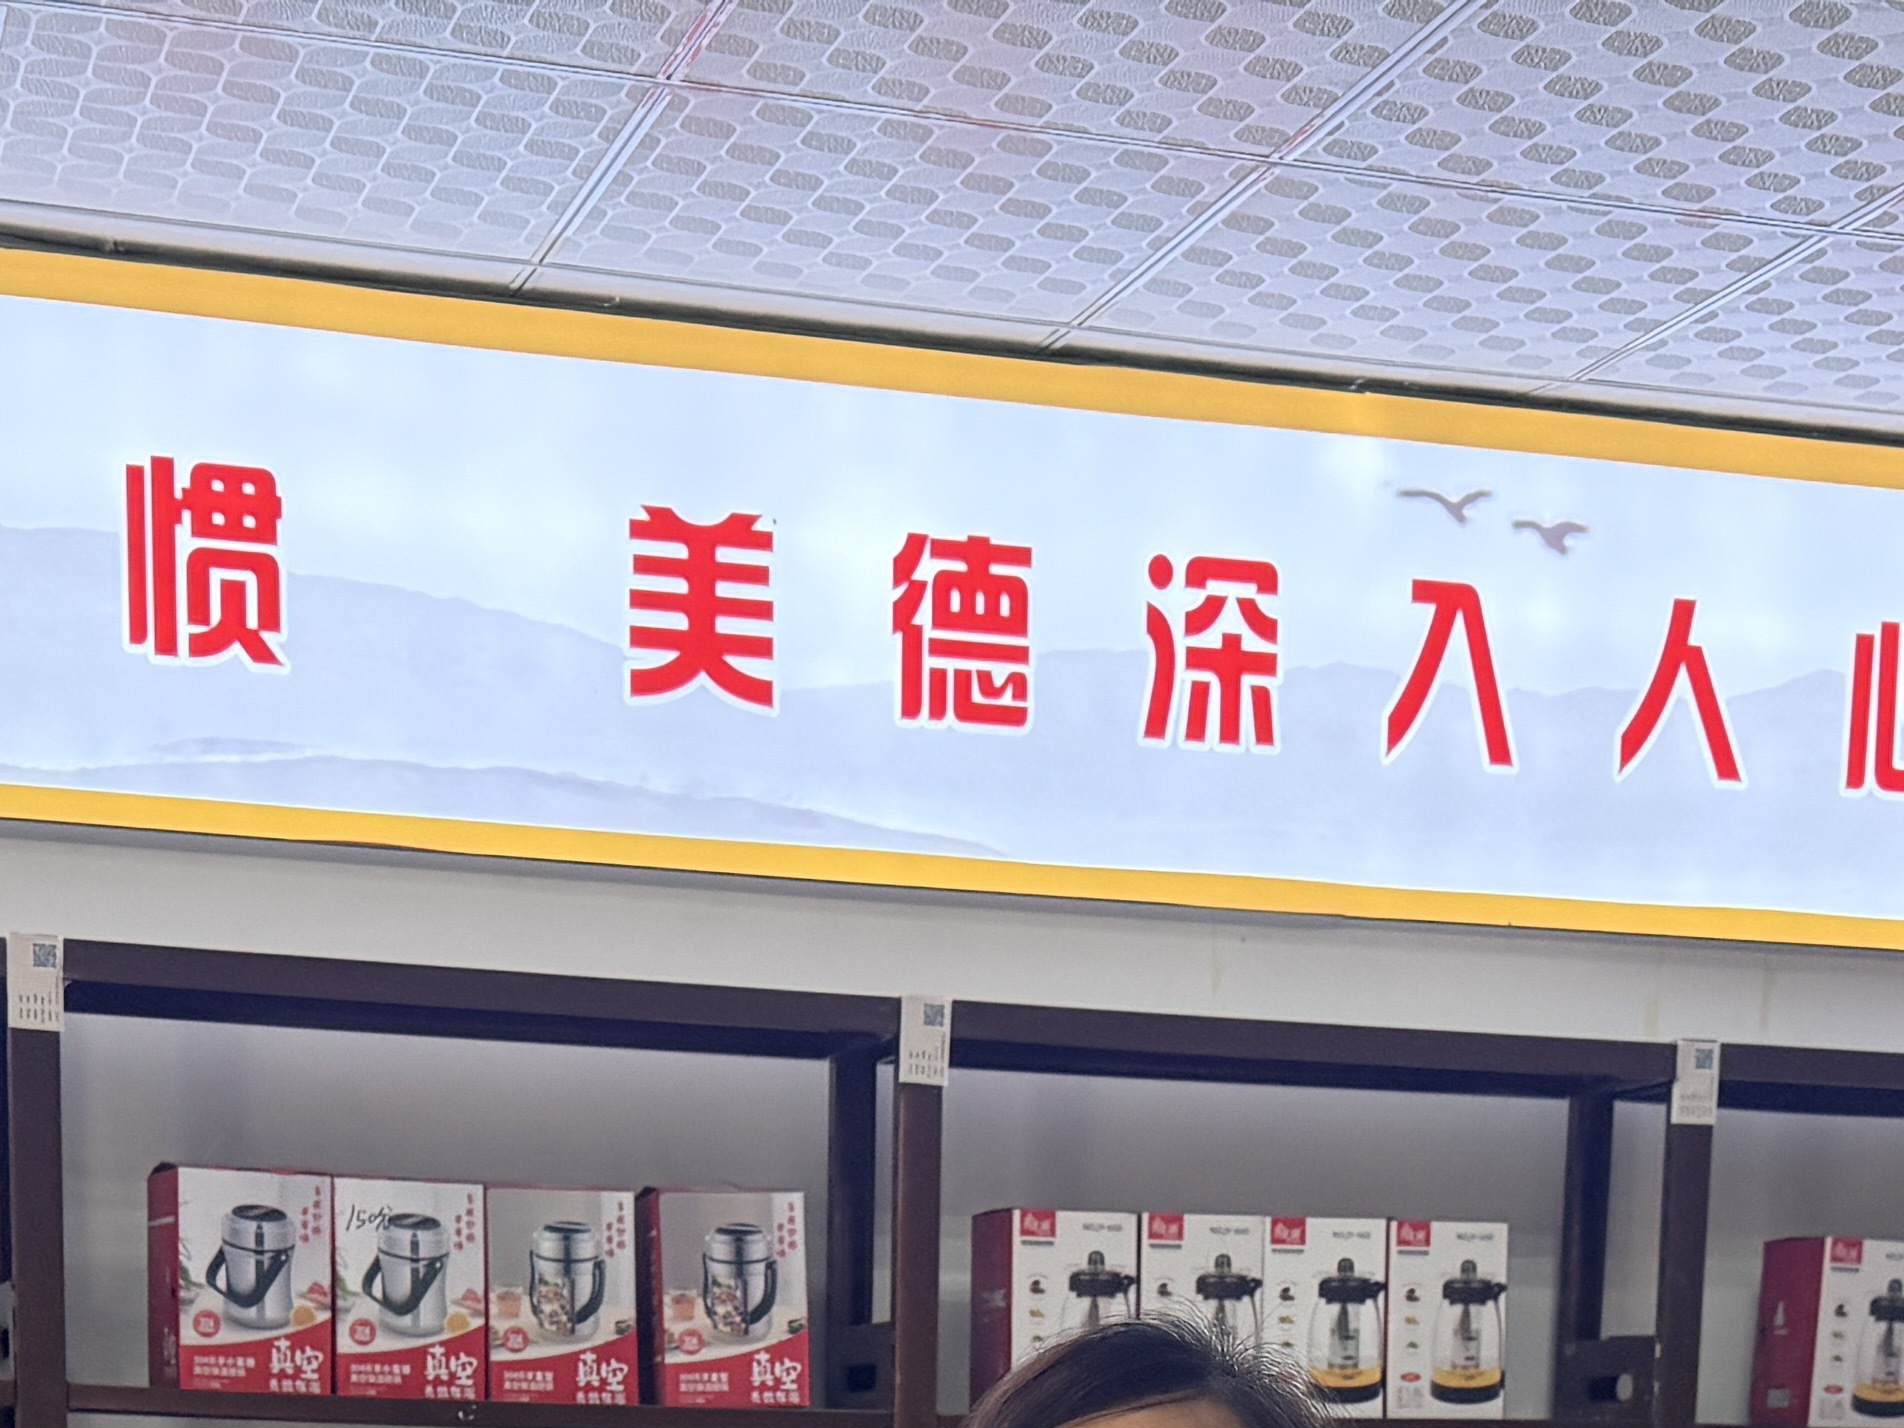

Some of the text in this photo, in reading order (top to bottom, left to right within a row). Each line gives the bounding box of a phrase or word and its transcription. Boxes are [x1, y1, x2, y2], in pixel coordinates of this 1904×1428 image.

[269, 1336, 325, 1380] 真空
[423, 1344, 479, 1387] 真空
[575, 1349, 629, 1392] 真空
[750, 1349, 802, 1392] 真空
